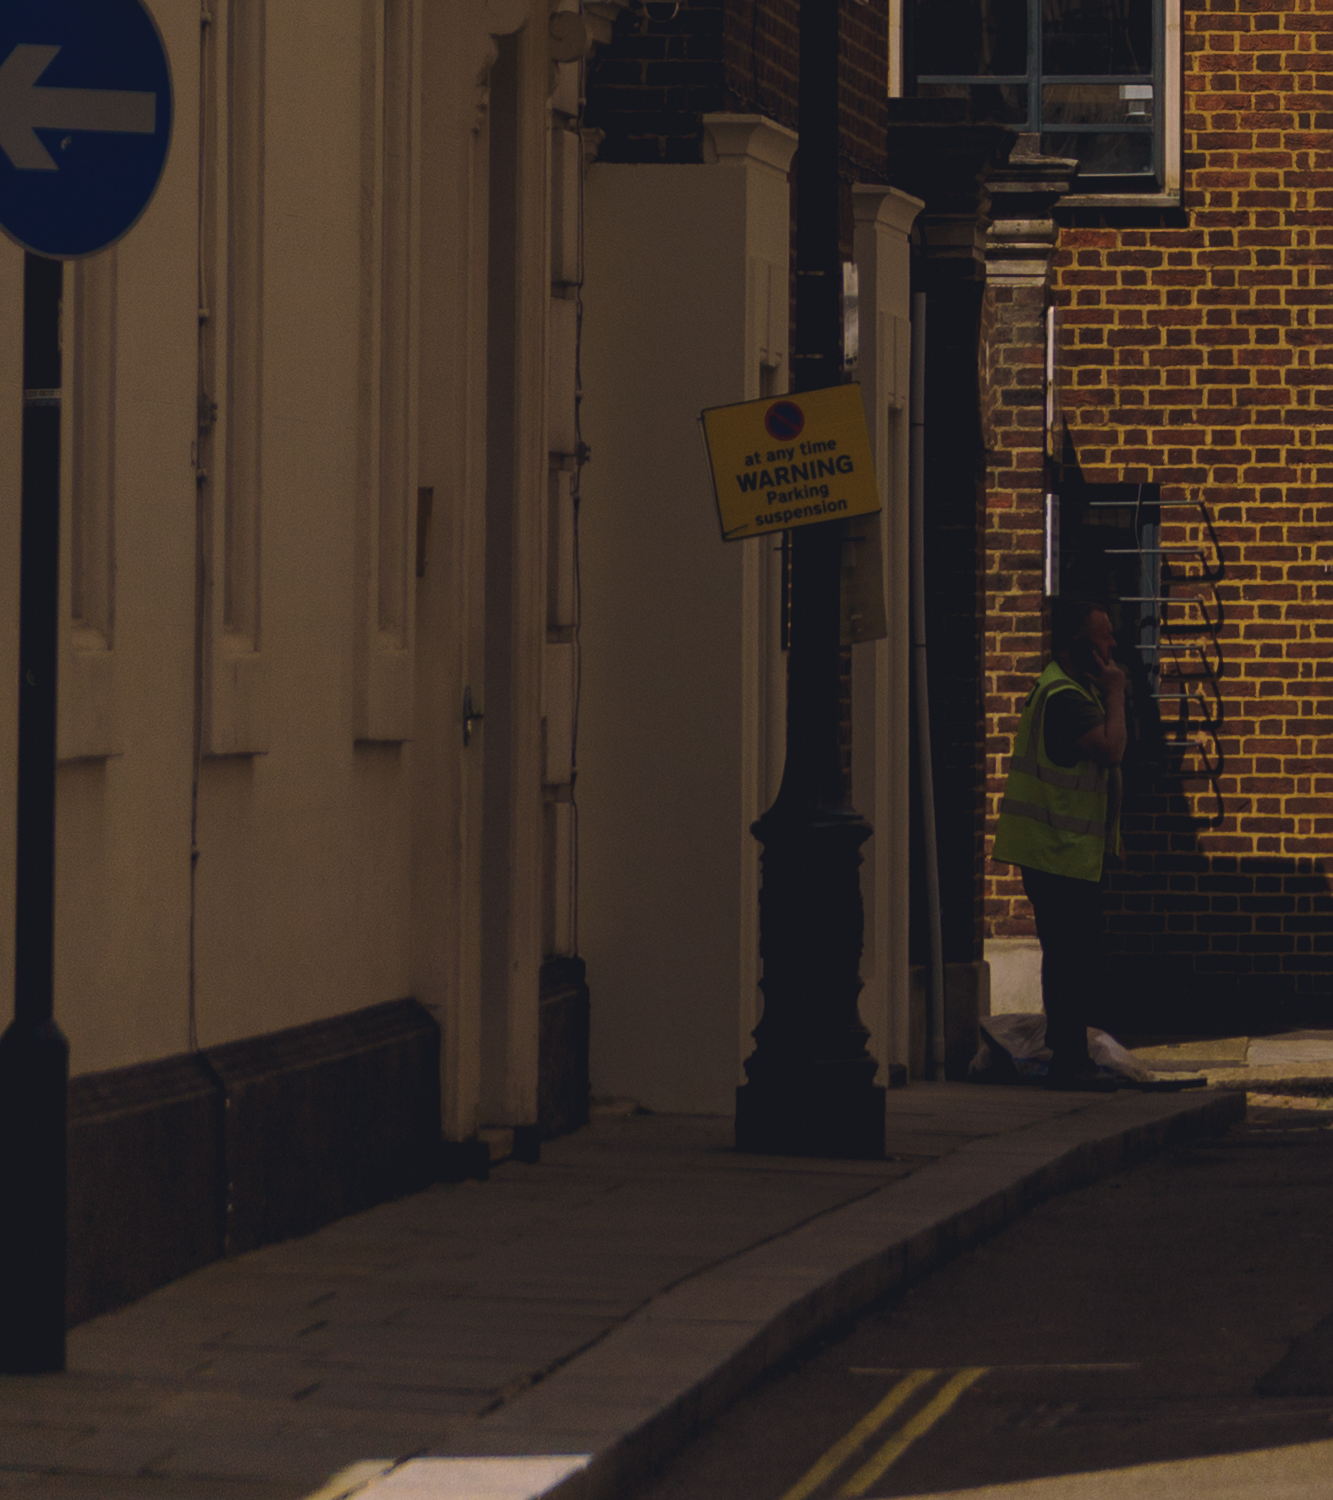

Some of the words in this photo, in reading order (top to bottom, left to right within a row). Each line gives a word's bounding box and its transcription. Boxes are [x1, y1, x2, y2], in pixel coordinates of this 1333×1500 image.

[744, 451, 761, 467] at
[766, 445, 795, 462] any
[799, 439, 837, 456] time
[736, 454, 854, 493] WARNING
[766, 483, 830, 505] Parking
[755, 498, 847, 526] suspension
